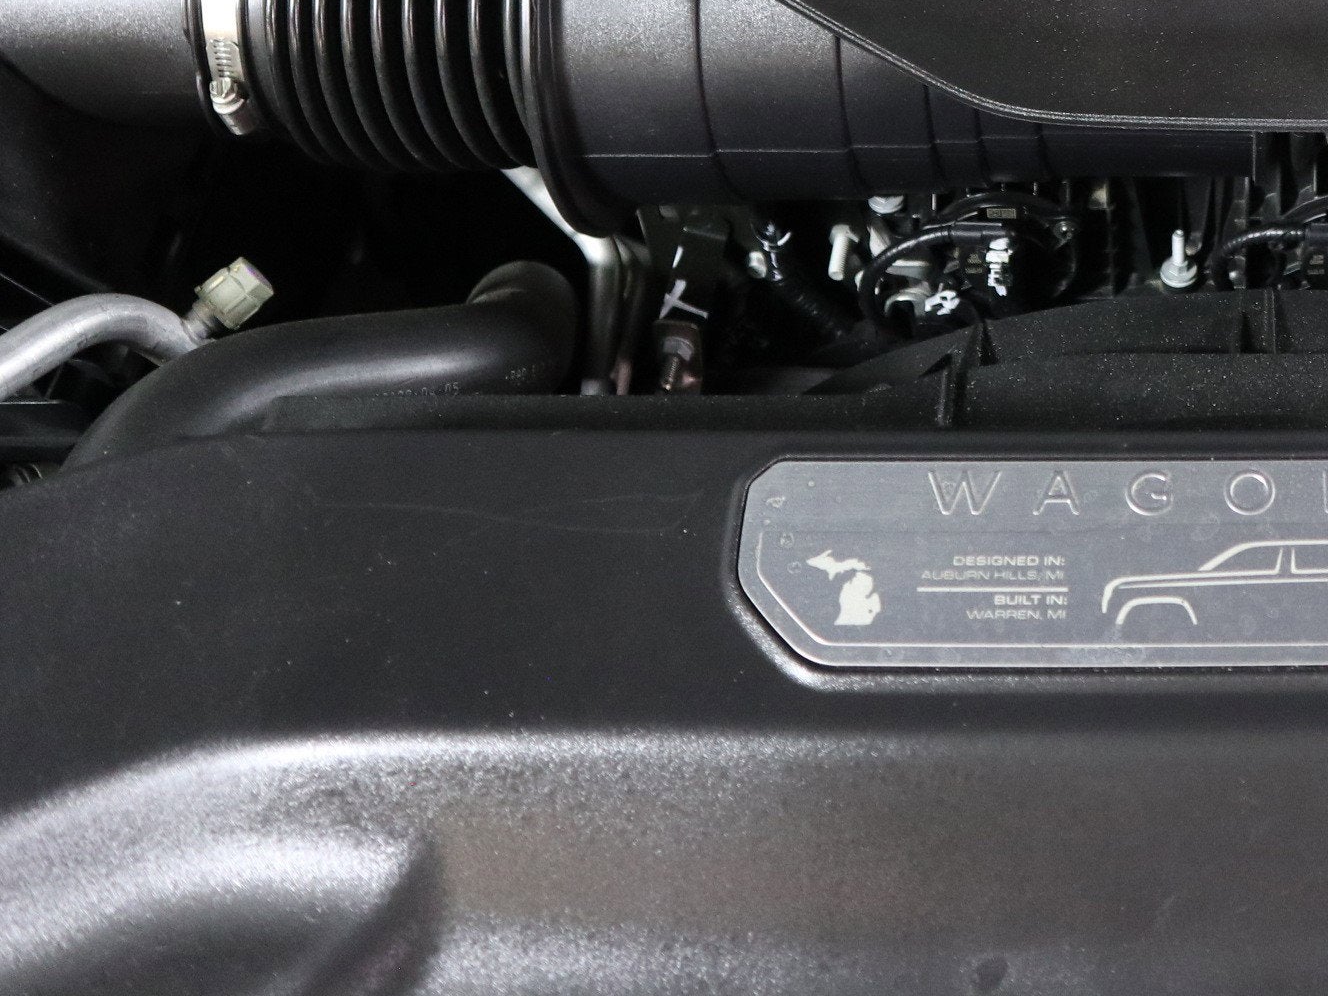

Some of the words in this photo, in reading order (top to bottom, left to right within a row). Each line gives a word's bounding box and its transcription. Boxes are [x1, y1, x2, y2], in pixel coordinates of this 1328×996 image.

[953, 556, 1039, 567] DESIGNED
[1044, 556, 1066, 566] IN:
[921, 570, 990, 580] AUBURN
[1045, 570, 1064, 580] MI
[994, 595, 1042, 606] BUILT
[1046, 594, 1068, 605] IN:
[1047, 610, 1066, 620] MI
